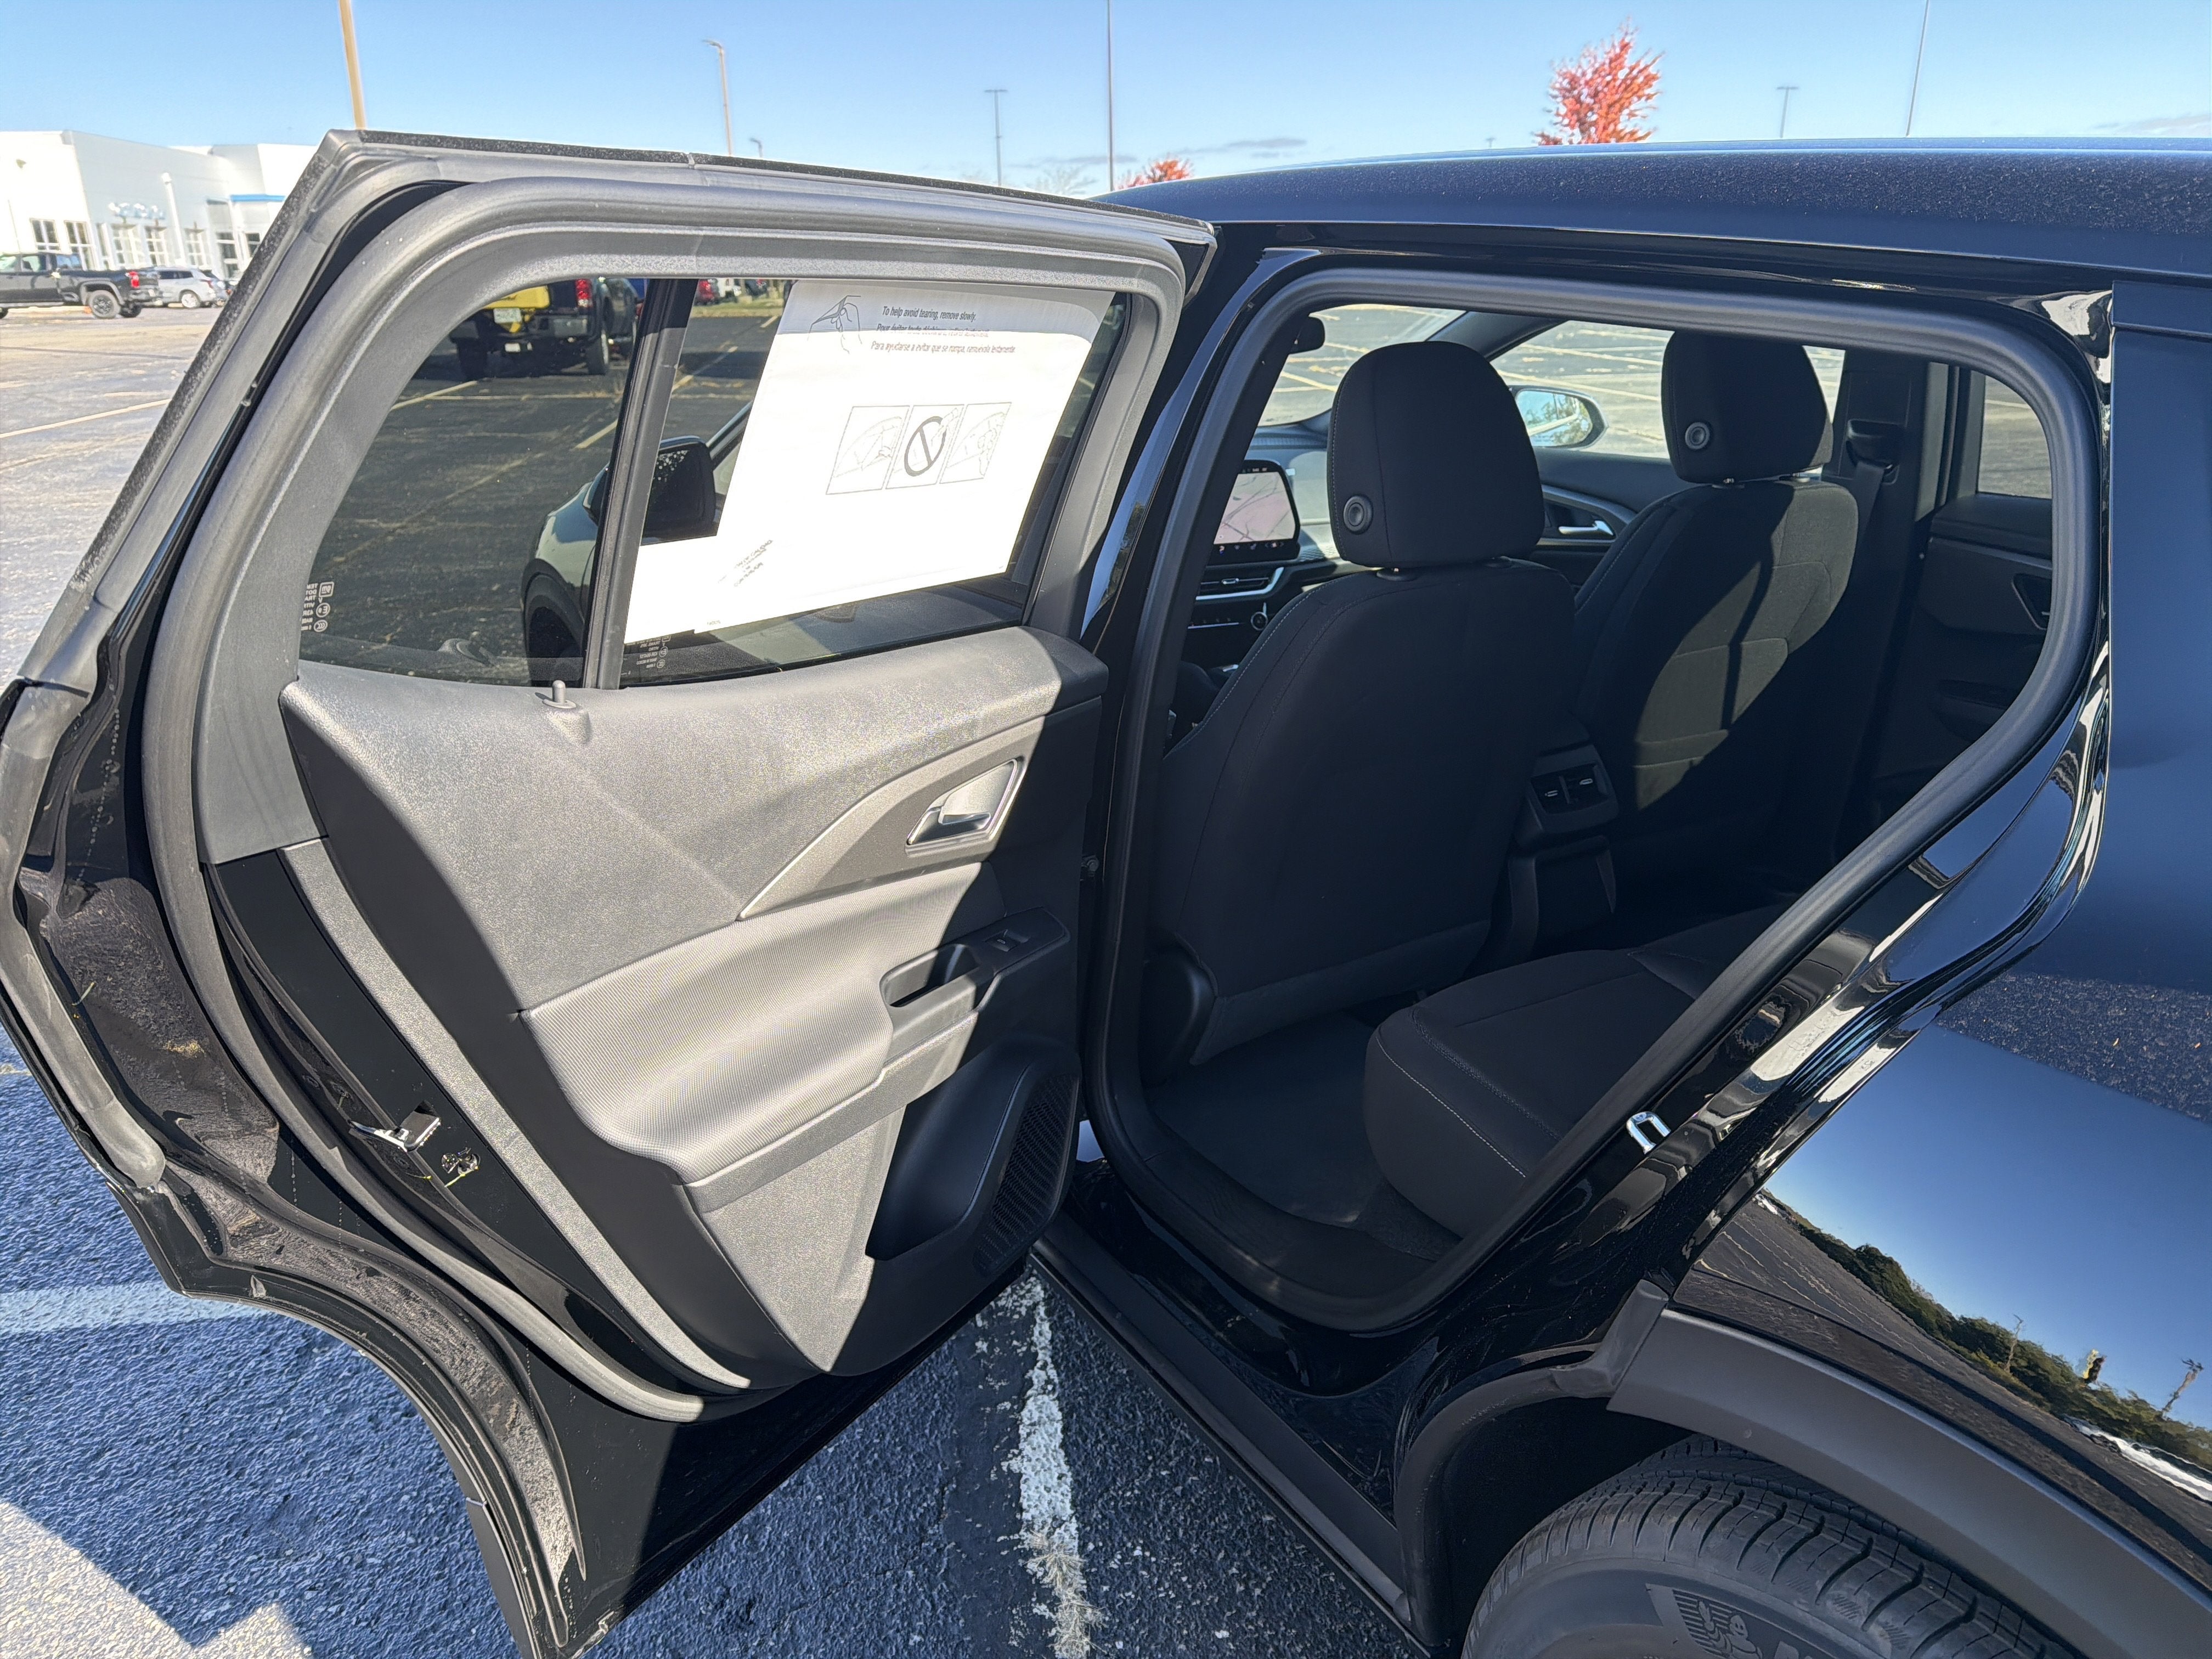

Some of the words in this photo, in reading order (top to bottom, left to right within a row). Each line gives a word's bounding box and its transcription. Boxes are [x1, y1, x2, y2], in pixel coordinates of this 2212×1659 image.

[882, 306, 890, 315] To
[890, 306, 903, 318] help
[904, 308, 919, 318] avoid
[919, 308, 939, 320] tearing,
[940, 312, 959, 320] remove
[960, 311, 976, 322] slowly.
[871, 340, 884, 351] Para
